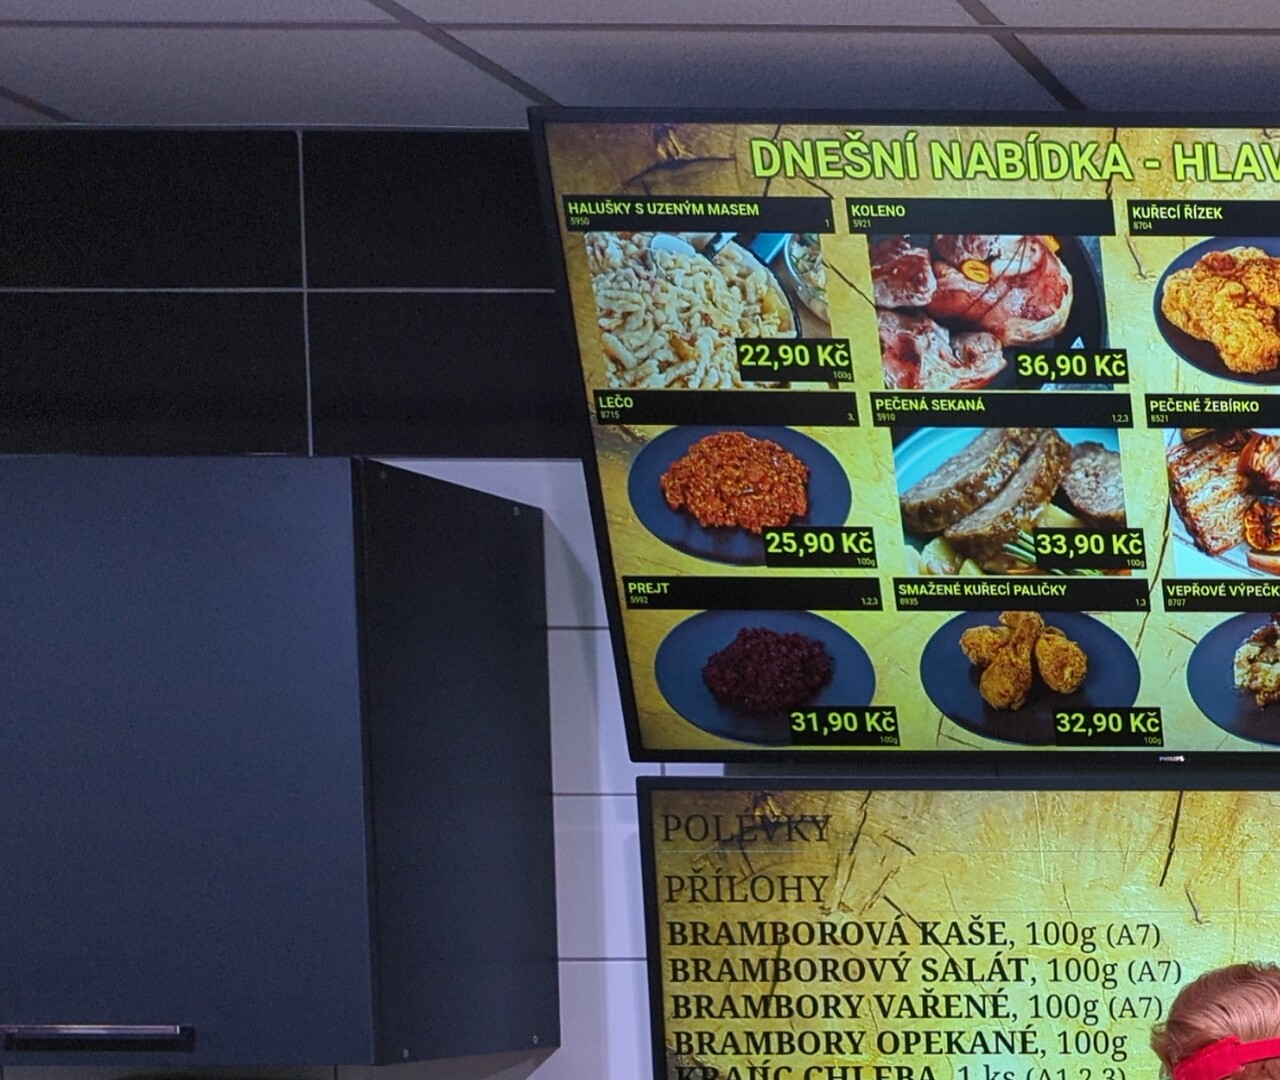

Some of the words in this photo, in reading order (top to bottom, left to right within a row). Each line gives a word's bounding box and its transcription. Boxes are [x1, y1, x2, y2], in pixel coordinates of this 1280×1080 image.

[751, 132, 917, 180] DNEŠNÍ
[932, 132, 1133, 181] NABÍDKA
[567, 198, 633, 216] HALUŠKY
[633, 201, 646, 216] S
[645, 198, 706, 217] UZENÝM
[706, 202, 761, 217] MASEM
[850, 203, 907, 218] KOLENO
[738, 343, 811, 371] 22,90
[815, 339, 852, 368] Kč
[874, 394, 930, 412] PEČENÁ
[930, 395, 987, 412] SEKANÁ
[626, 581, 671, 595] PREJT
[1165, 581, 1228, 598] VEPŘOVÉ
[1054, 711, 1124, 737] 32,90
[1128, 710, 1163, 734] Kč
[662, 809, 832, 843] POLÉVKY
[663, 868, 830, 904] PŘÍLOHY
[667, 916, 907, 947] BRAMBOROVÁ
[920, 915, 1016, 950] KAŠE,
[1025, 921, 1097, 953] 100g
[1105, 923, 1161, 950] (A7)
[670, 952, 912, 983] BRAMBOROVÝ
[921, 953, 1038, 986] SALÁT,
[1047, 958, 1118, 988] 100g
[1127, 959, 1182, 986] (A7)
[671, 994, 864, 1020] BRAMBORY
[873, 987, 1018, 1022] VAŘENÉ,
[1028, 994, 1099, 1024] 100g
[1109, 996, 1163, 1022] (A7)
[674, 1030, 866, 1055] BRAMBORY
[876, 1025, 1047, 1059] OPEKANÉ,
[1056, 1030, 1128, 1062] 100g
